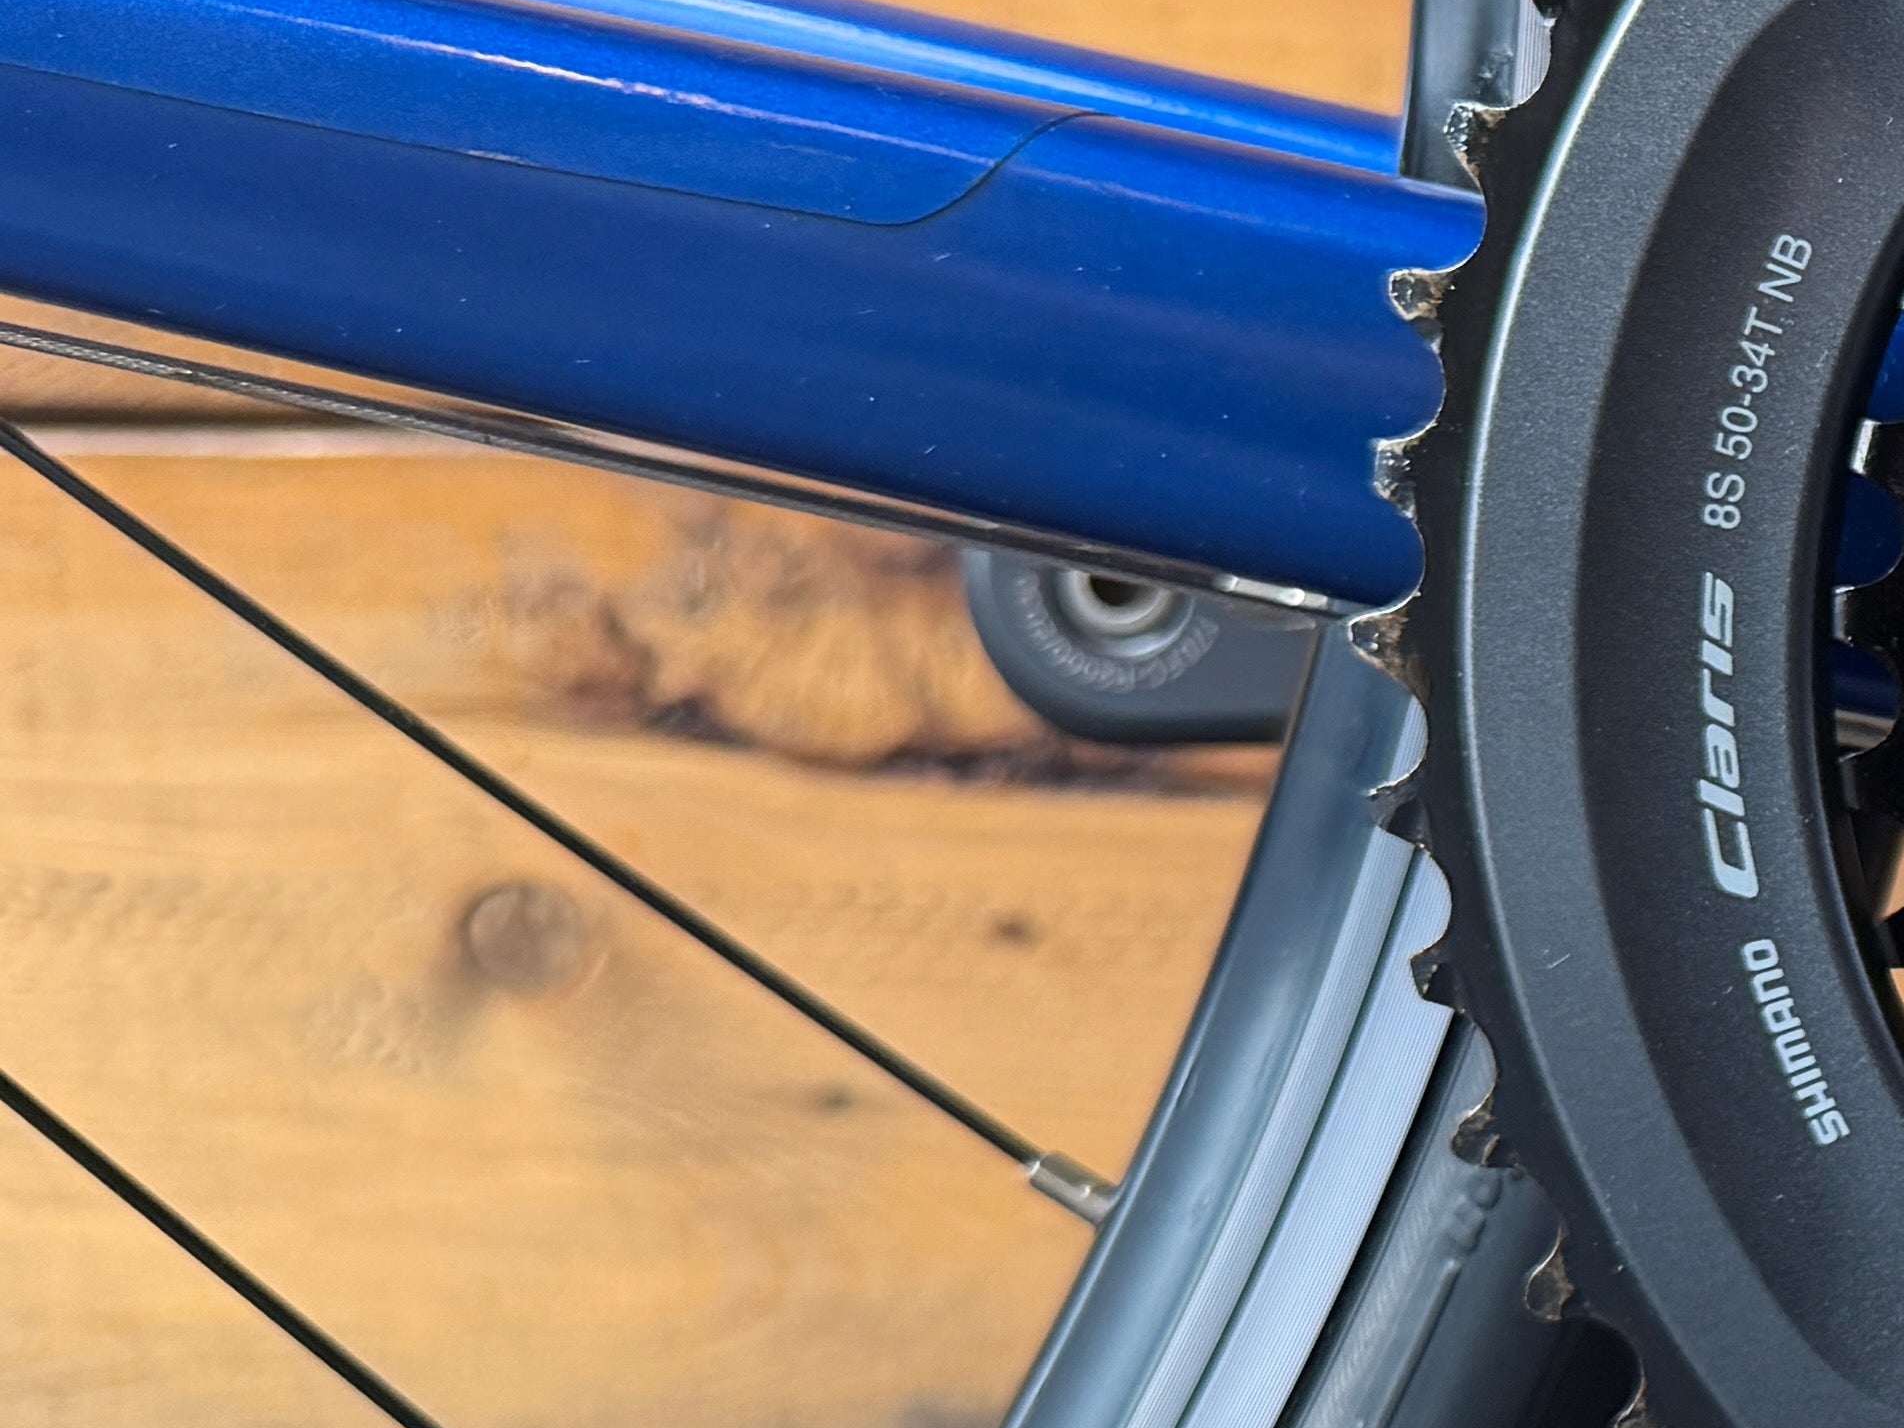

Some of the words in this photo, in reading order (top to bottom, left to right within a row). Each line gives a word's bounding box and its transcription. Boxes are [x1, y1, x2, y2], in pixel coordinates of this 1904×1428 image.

[1756, 232, 1813, 304] NB
[1713, 305, 1783, 461] 50-34T
[1702, 470, 1746, 530] 8S
[1696, 570, 1761, 900] Claris
[1740, 937, 1852, 1147] SHIMANO
